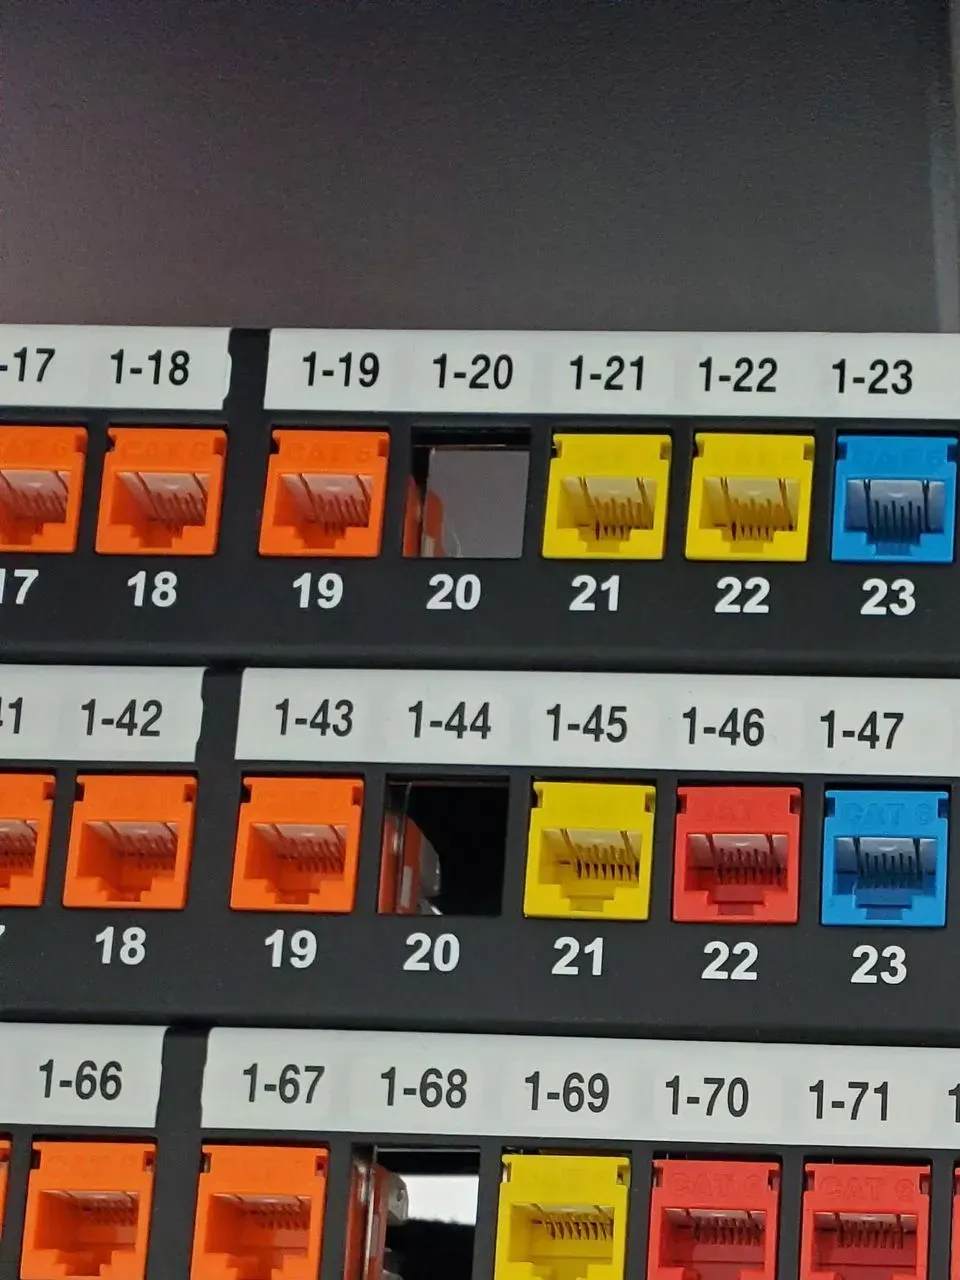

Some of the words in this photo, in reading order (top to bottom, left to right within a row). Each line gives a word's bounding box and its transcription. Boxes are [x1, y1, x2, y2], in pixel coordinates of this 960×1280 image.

[110, 348, 190, 386] 1-18
[302, 351, 380, 388] 1-19
[432, 353, 514, 390] 1-20
[569, 354, 644, 391] 1-21
[698, 356, 778, 393] 1-22
[832, 358, 913, 395] 1-23
[127, 570, 178, 608] 18
[292, 572, 344, 609] 19
[426, 573, 481, 610] 20
[568, 574, 620, 612] 21
[714, 576, 771, 614] 22
[860, 578, 916, 616] 23
[81, 698, 163, 737] 1-42
[275, 698, 354, 737] 1-43
[408, 700, 492, 740] 1-44
[546, 703, 628, 743] 1-45
[682, 706, 765, 747] 1-46
[820, 709, 904, 750] 1-47
[95, 926, 147, 965] 18
[264, 929, 317, 969] 19
[402, 932, 460, 972] 20
[551, 936, 604, 976] 21
[701, 940, 759, 981] 22
[850, 944, 907, 985] 23
[39, 1058, 123, 1101] 1-66
[242, 1062, 325, 1104] 1-67
[380, 1066, 468, 1109] 1-68
[524, 1070, 610, 1114] 1-69
[665, 1075, 749, 1118] 1-70
[809, 1079, 889, 1122] 1-71
